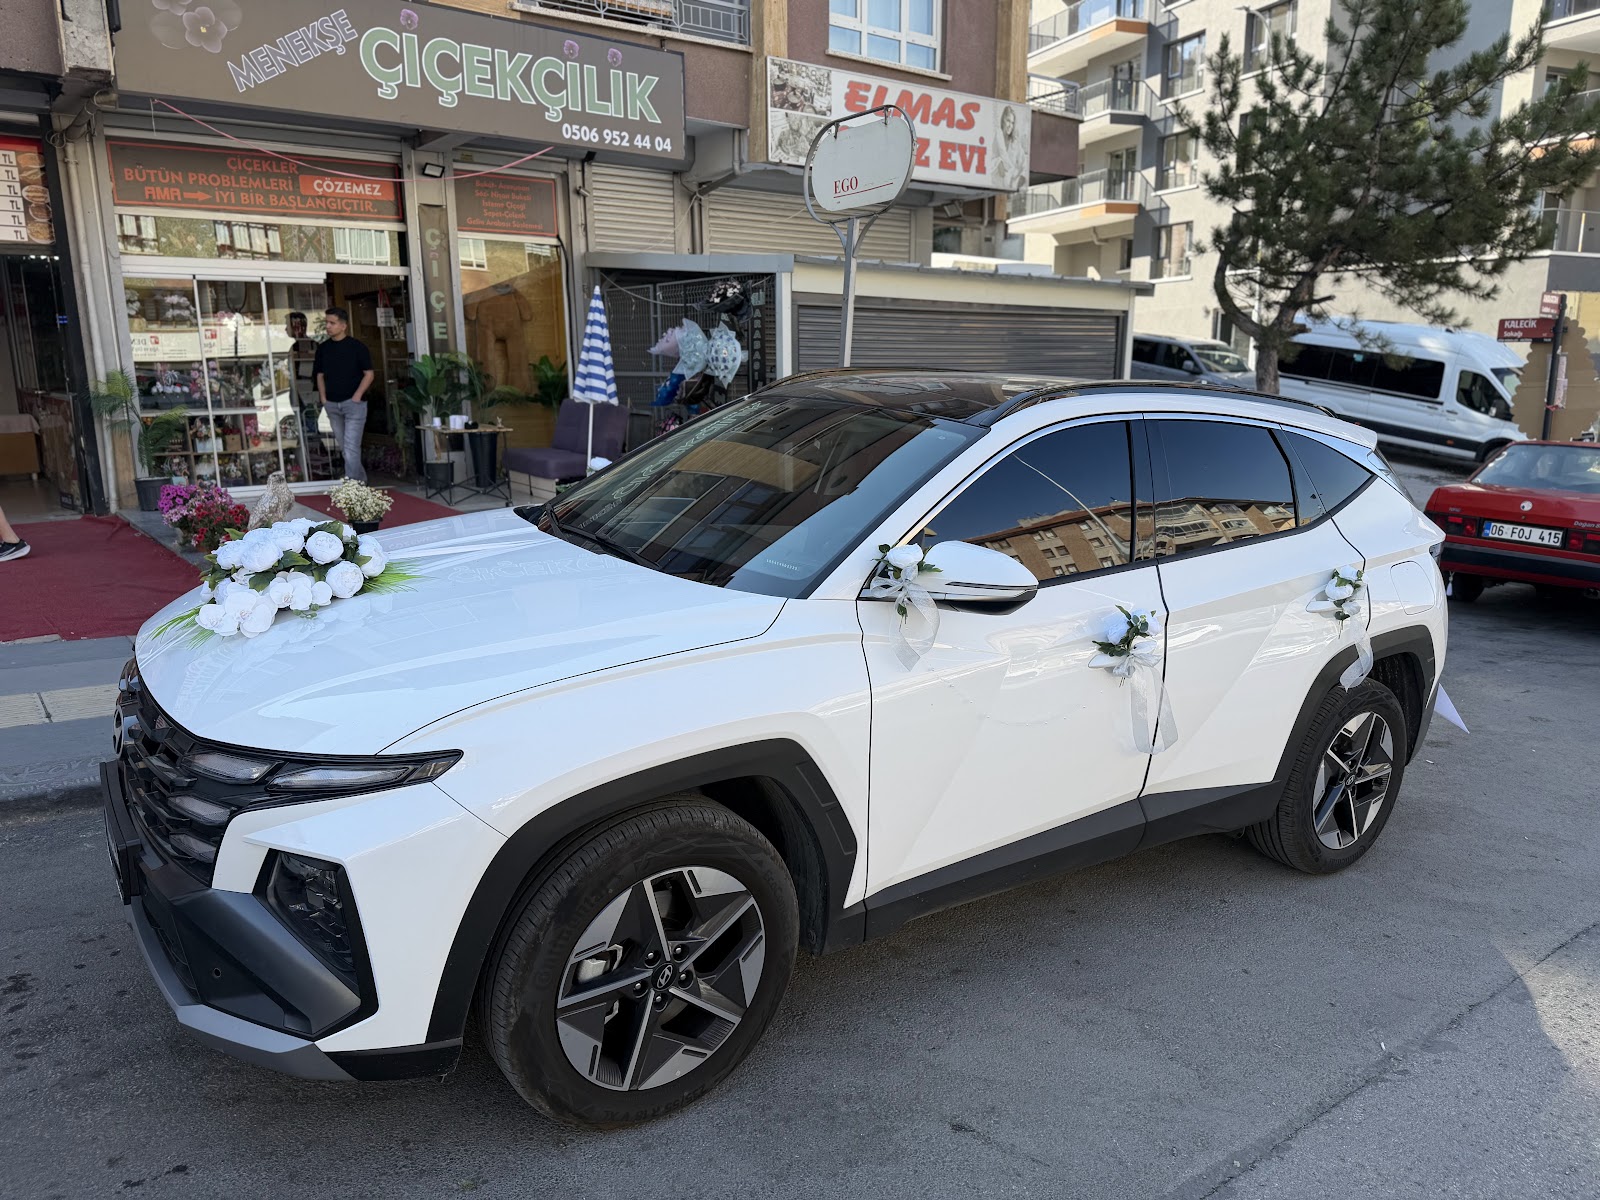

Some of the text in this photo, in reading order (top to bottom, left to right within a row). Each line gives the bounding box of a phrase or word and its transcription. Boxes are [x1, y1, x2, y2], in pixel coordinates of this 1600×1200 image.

[227, 9, 358, 93] MENEKŞE
[844, 80, 981, 131] ELMAS
[562, 123, 672, 152] 0506 952 44 04
[2, 153, 13, 164] TL
[227, 155, 299, 175] ÇİÇEKLER
[938, 137, 987, 174] EVİ
[5, 169, 16, 180] TL
[124, 165, 382, 196] BÜTÜN PROBLEMLERİ ÇÖZEMEZ
[7, 185, 18, 195] TL
[833, 176, 859, 194] EGO
[9, 200, 20, 210] TL
[144, 186, 182, 201] AMA
[215, 187, 236, 203] İYİ
[240, 190, 265, 206] BİR
[11, 215, 22, 225] TL
[14, 230, 25, 240] TL
[1504, 318, 1537, 329] KALECİK
[1490, 524, 1561, 544] 06 FOJ 415
